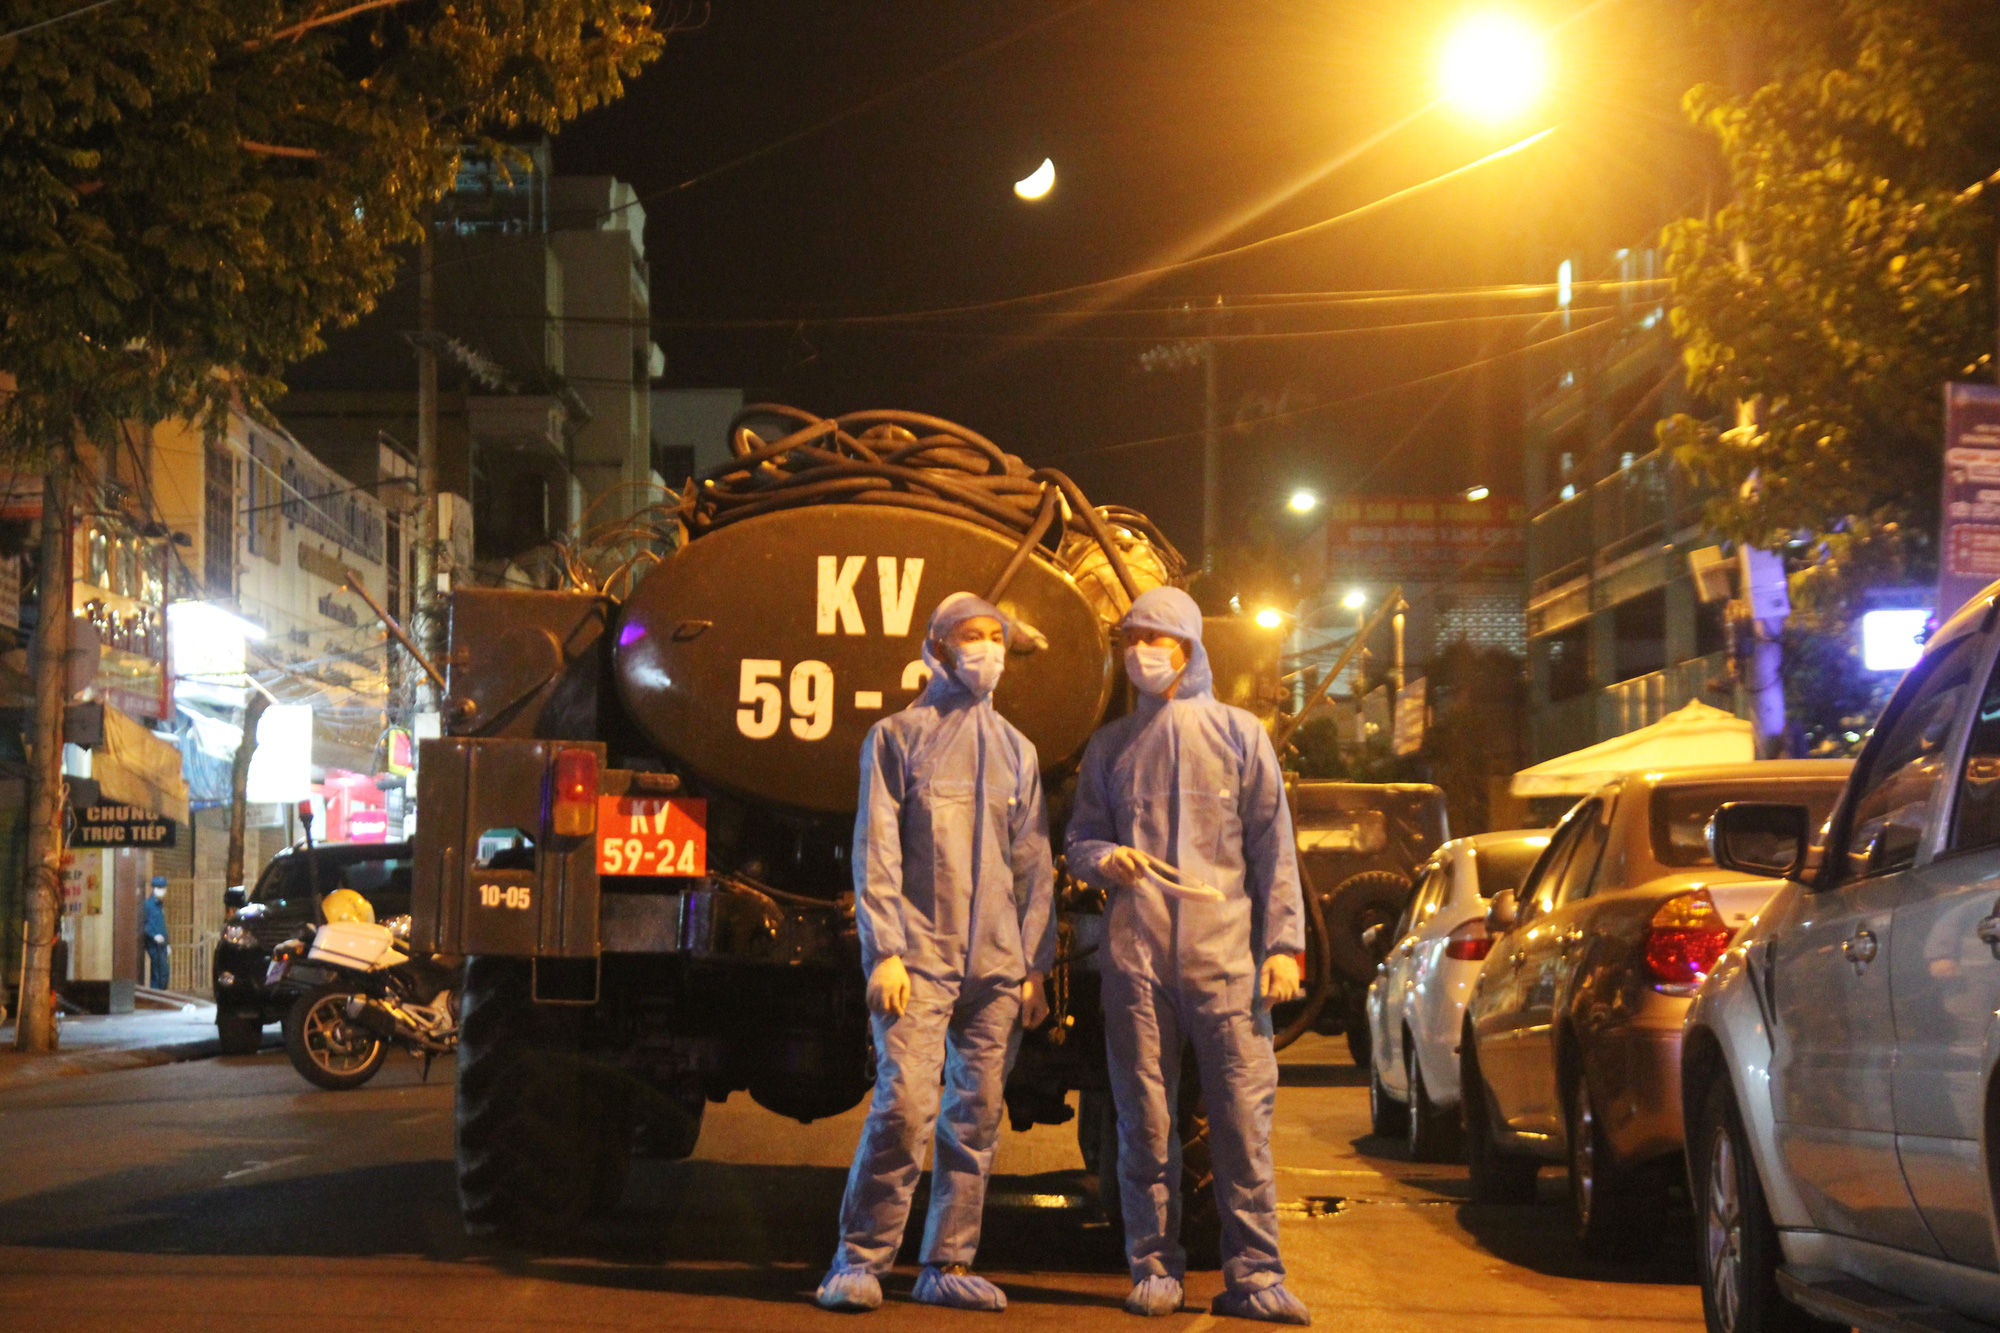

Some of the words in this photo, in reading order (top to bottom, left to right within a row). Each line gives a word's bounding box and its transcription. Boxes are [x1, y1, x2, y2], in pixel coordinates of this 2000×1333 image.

[816, 555, 925, 637] KV
[630, 799, 670, 835] KV
[603, 837, 695, 874] 59-24
[479, 883, 531, 910] 10-05
